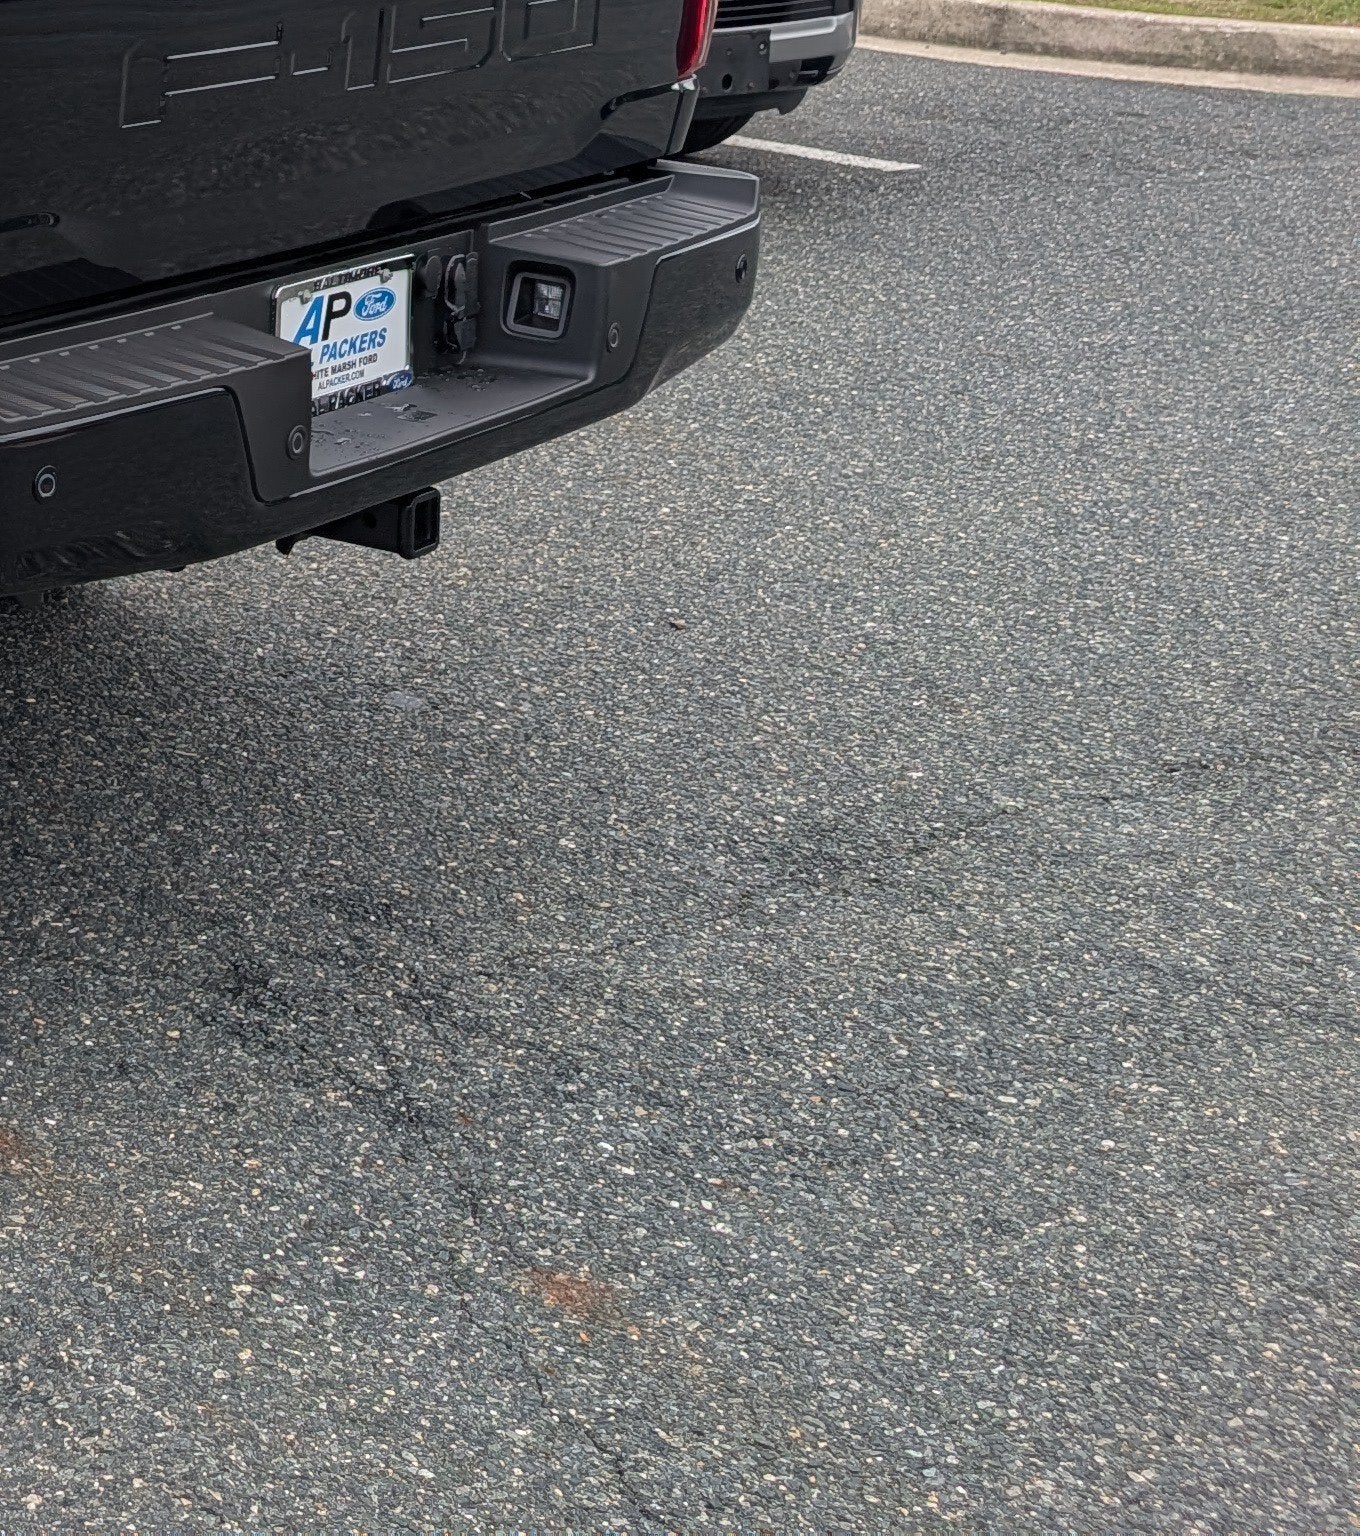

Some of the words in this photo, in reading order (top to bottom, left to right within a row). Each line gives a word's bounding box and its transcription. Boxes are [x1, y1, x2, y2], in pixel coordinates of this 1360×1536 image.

[292, 291, 352, 345] AP
[361, 292, 390, 317] Ford
[319, 327, 387, 364] PACKERS
[330, 358, 357, 375] MARSH
[358, 352, 378, 367] FORD
